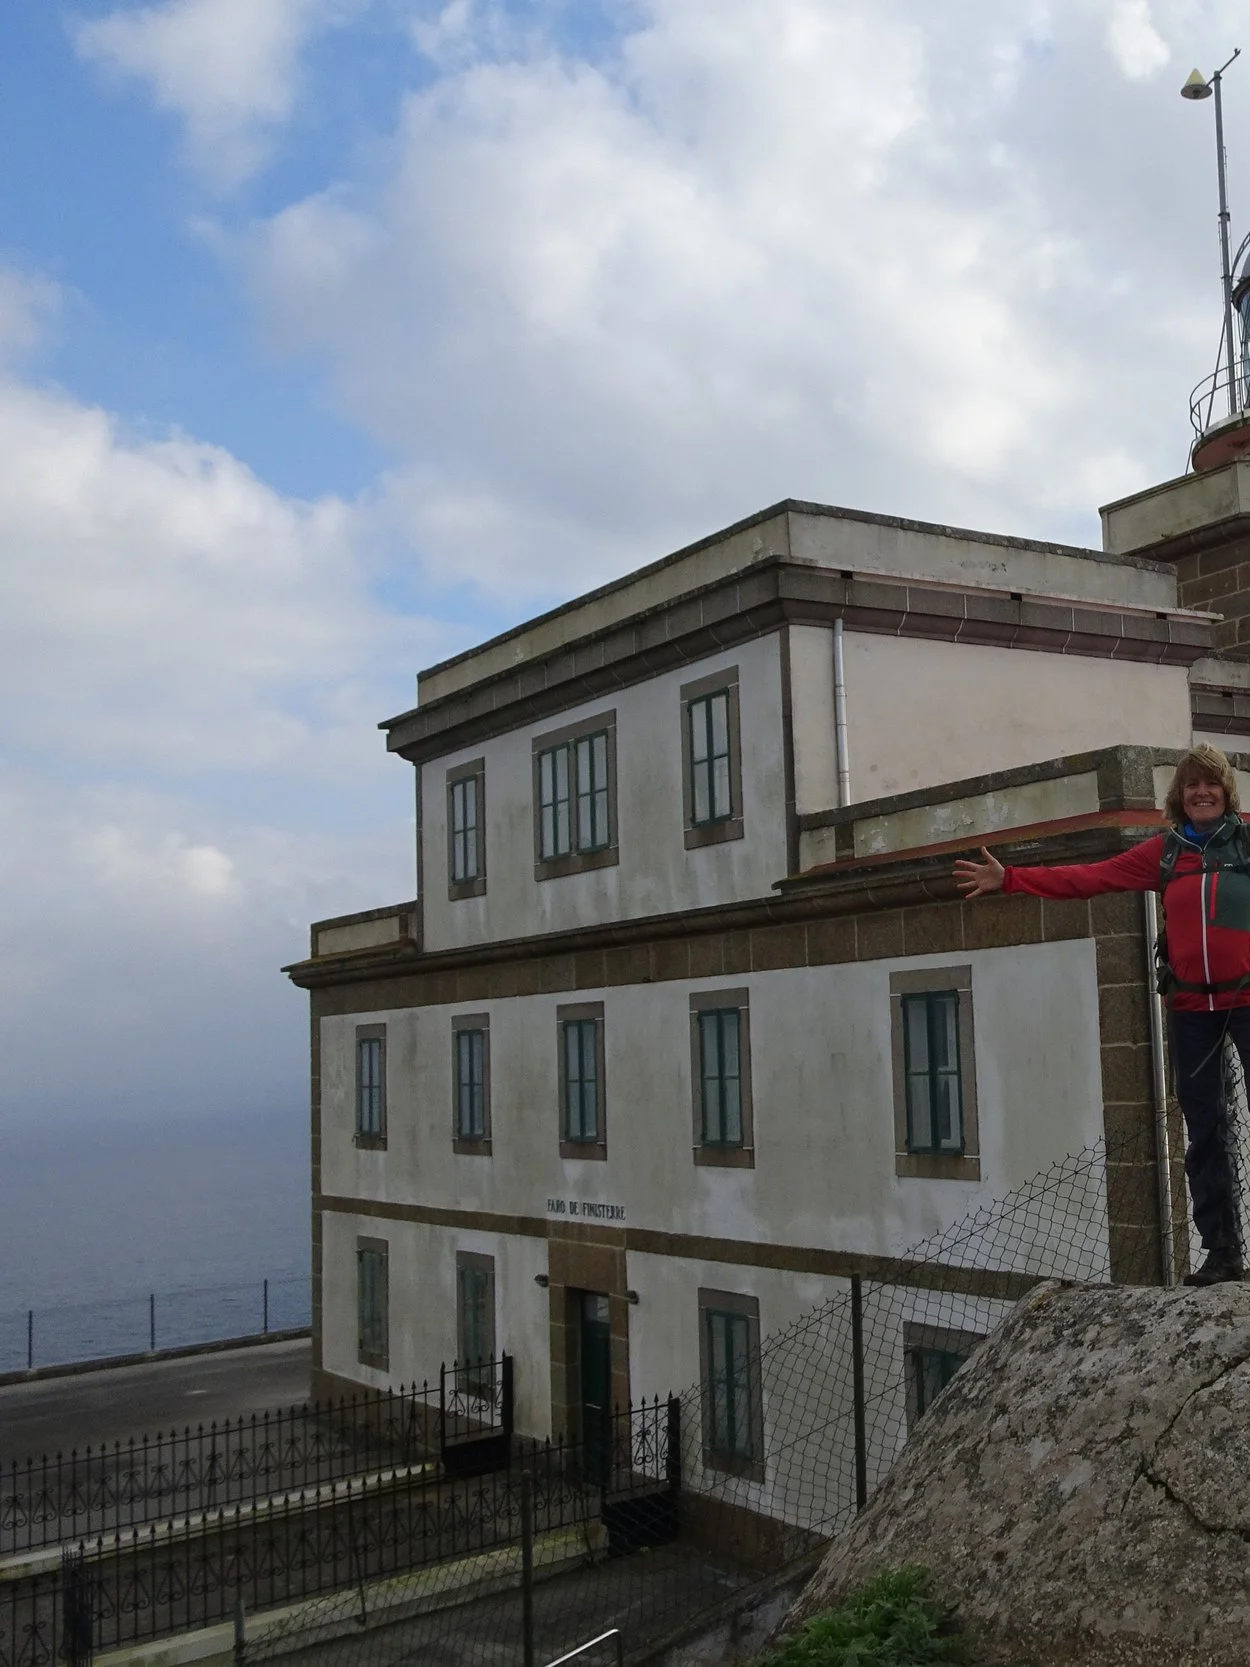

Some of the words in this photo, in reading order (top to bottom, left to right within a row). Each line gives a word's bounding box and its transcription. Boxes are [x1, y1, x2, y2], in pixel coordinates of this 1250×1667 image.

[547, 1199, 565, 1213] FARO
[569, 1201, 579, 1215] DE
[583, 1202, 626, 1220] FINISTERRE
